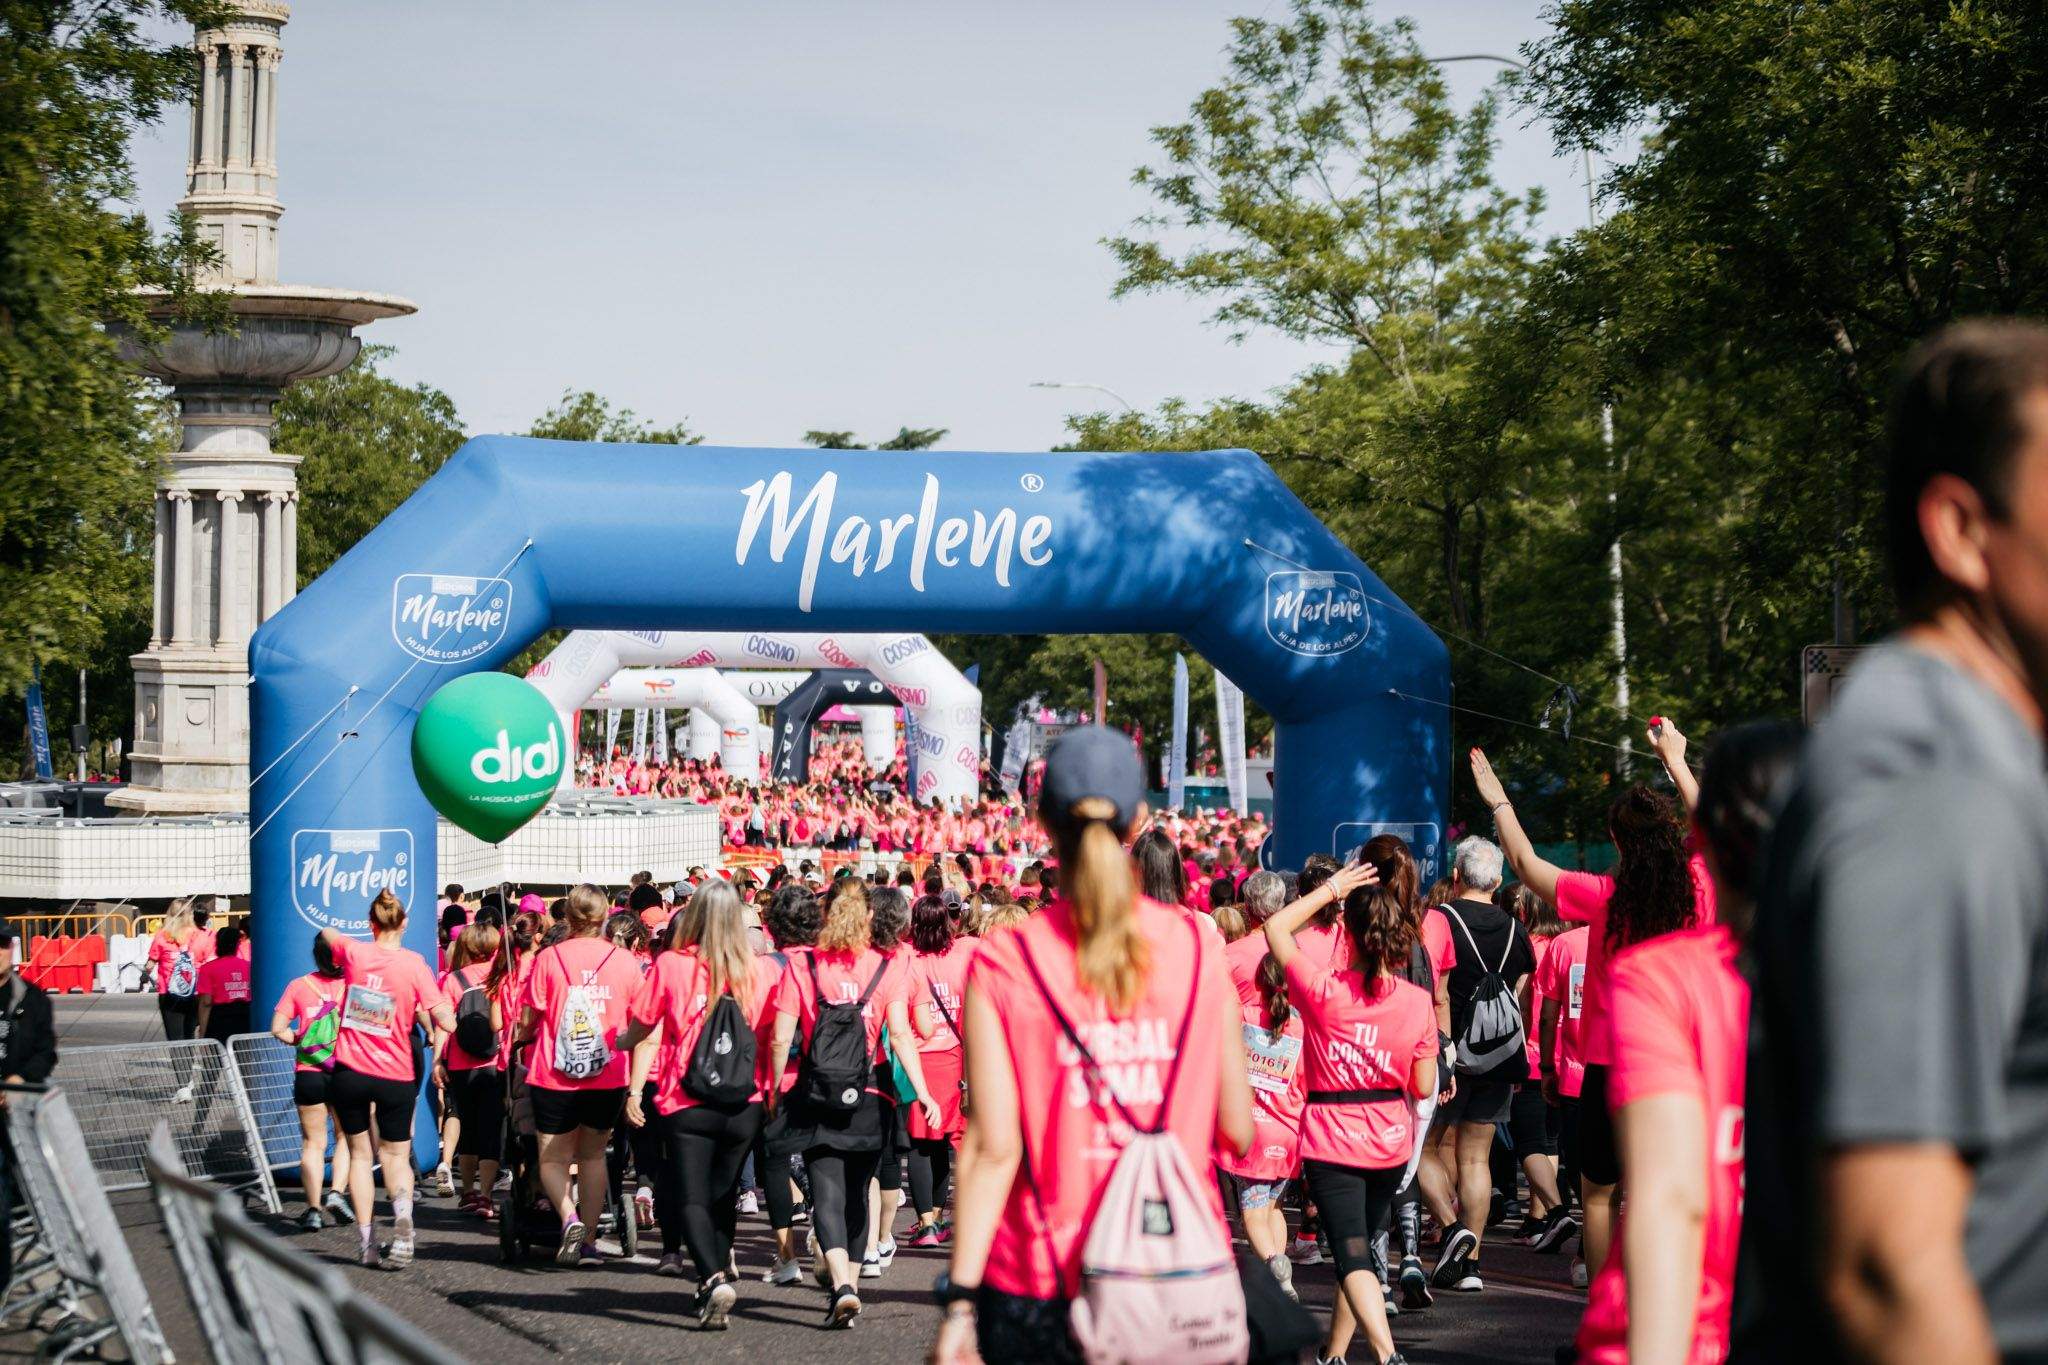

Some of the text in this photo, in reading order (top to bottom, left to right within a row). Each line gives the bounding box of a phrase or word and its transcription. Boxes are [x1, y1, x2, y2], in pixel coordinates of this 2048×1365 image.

[405, 636, 489, 659] HIJA DE LOS ALPES
[748, 635, 795, 662] COSMO
[883, 635, 928, 664] COSMO
[1278, 631, 1359, 652] HIJA DE LOS ALPES
[306, 903, 369, 930] HIJA DE LOS
[366, 973, 383, 990] TU
[841, 981, 859, 1001] TU
[934, 982, 949, 995] TU
[1354, 1021, 1379, 1047] TU
[564, 1060, 585, 1074] DO
